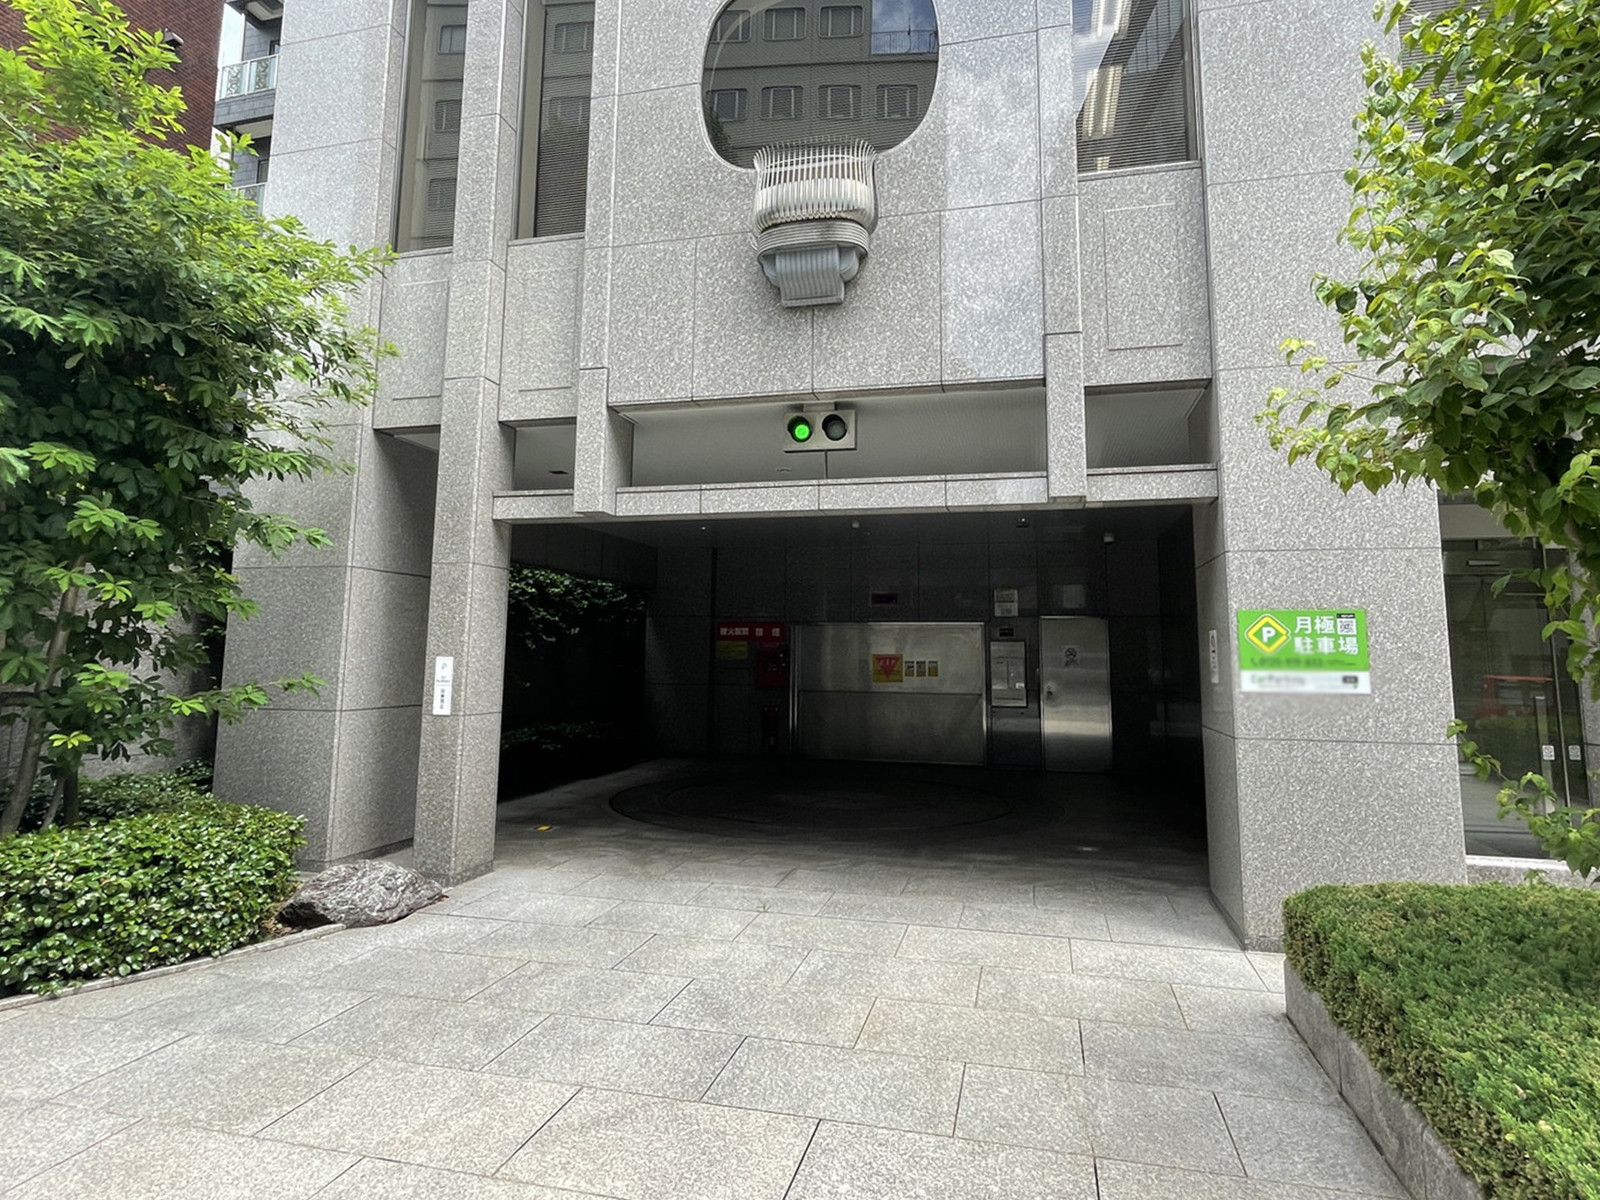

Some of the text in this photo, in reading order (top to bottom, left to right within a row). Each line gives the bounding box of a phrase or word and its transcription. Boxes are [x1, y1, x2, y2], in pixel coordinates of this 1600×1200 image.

[1294, 616, 1335, 634] 月極
[1262, 627, 1276, 643] P
[1294, 636, 1359, 655] 駐車場
